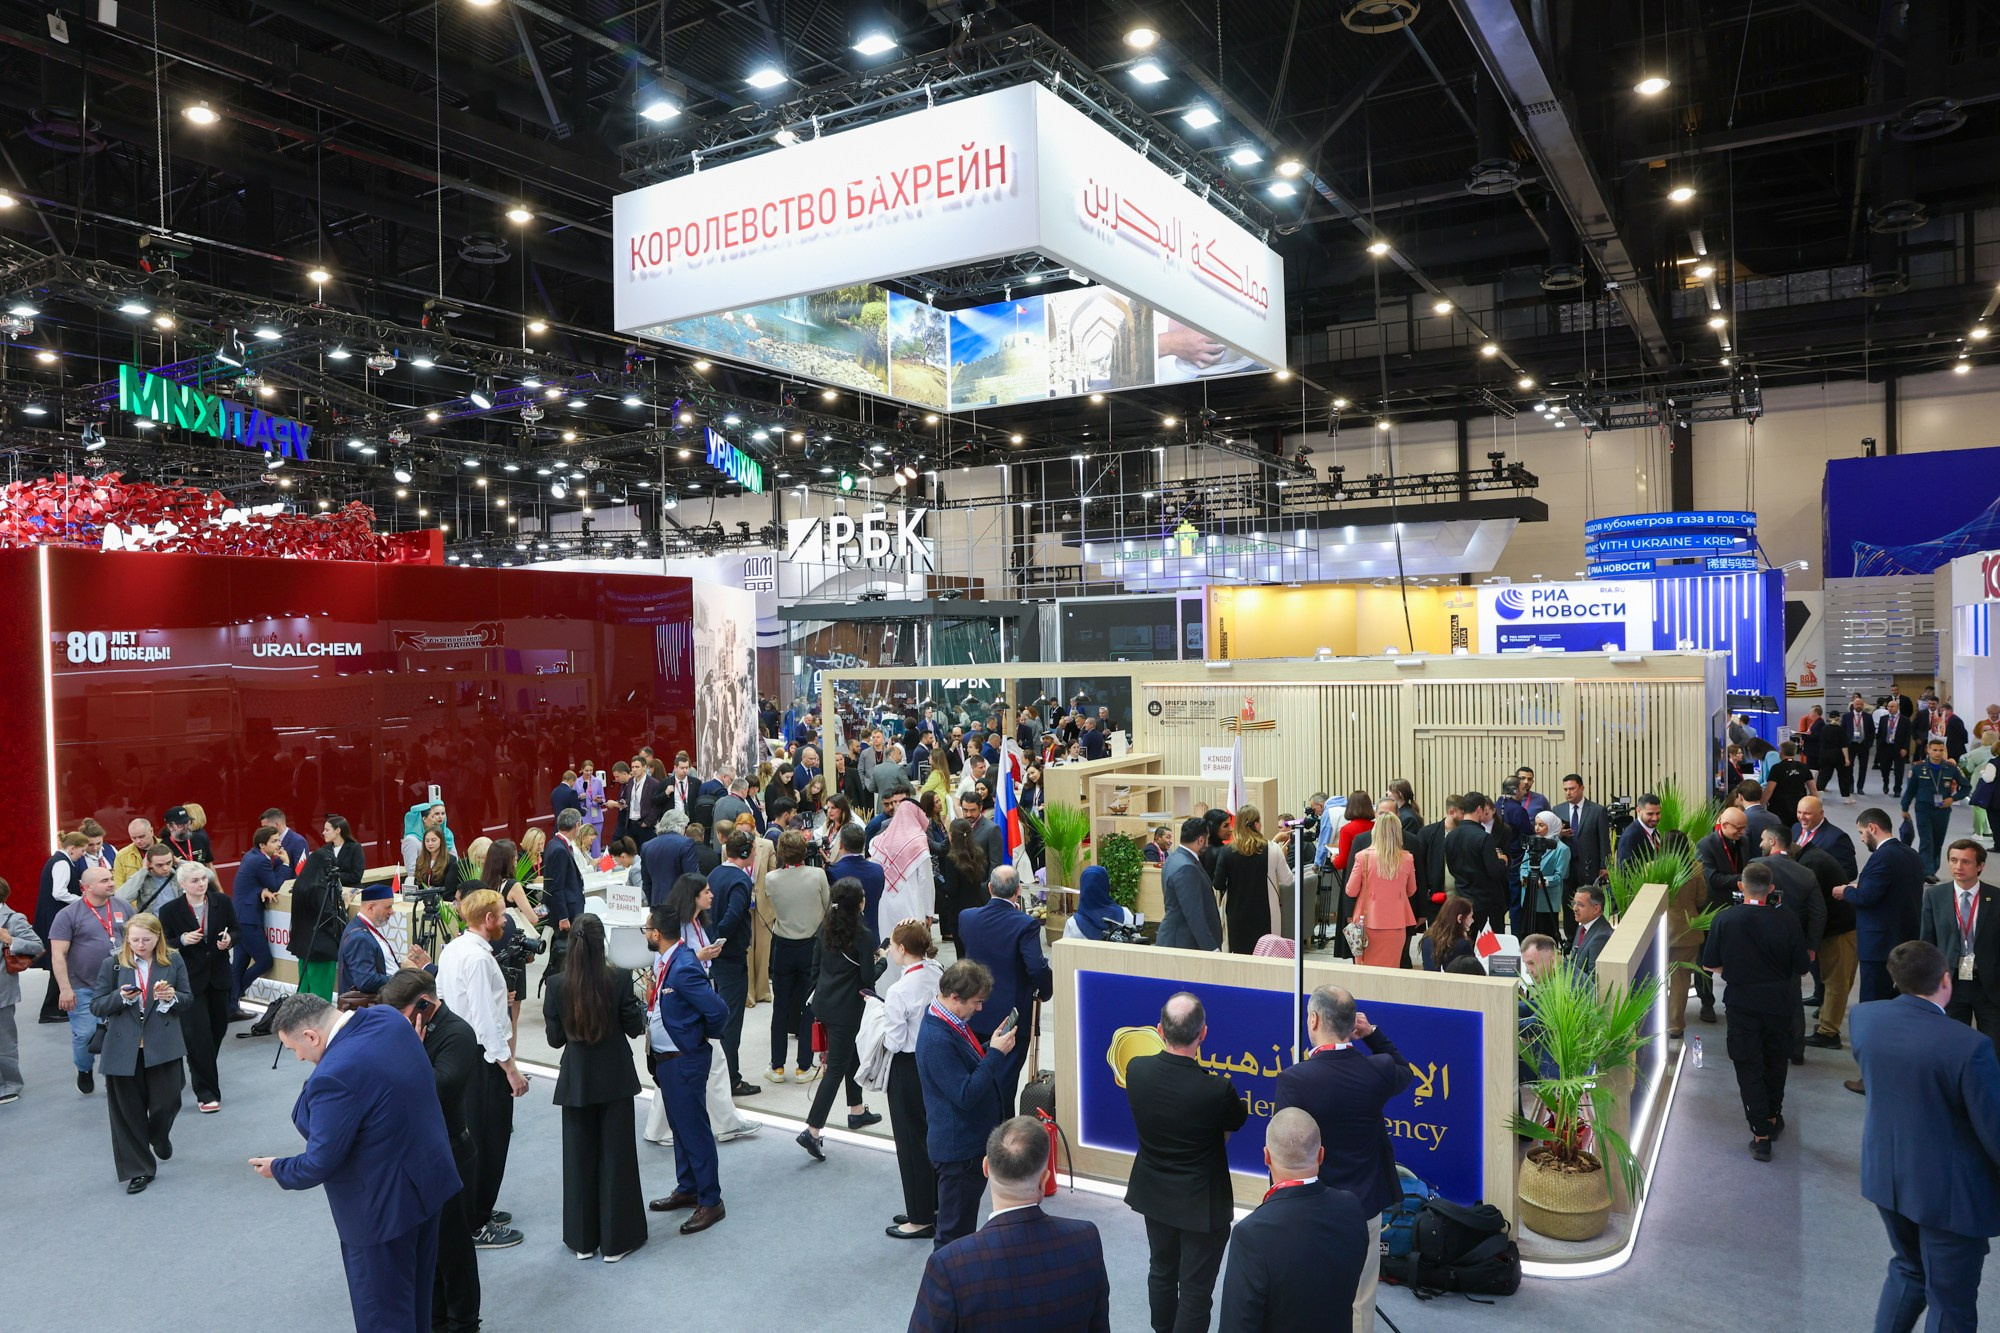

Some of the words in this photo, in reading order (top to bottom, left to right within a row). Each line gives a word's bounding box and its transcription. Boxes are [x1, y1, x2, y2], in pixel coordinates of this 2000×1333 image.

[630, 187, 837, 271] КОРОЛЕВСТВО
[846, 141, 1007, 219] БАХРЕЙН
[1083, 178, 1183, 260] البحرين
[1191, 231, 1269, 310] مملكة
[704, 426, 763, 494] УРАЛХИМ
[1603, 516, 1673, 531] кубометров
[1677, 515, 1704, 524] газа
[1707, 515, 1714, 523] в
[1717, 514, 1735, 524] год
[829, 507, 931, 561] РБК
[1631, 537, 1692, 549] UKRAINE
[1113, 548, 1178, 560] ROSNEFT
[1603, 562, 1650, 573] НОВОСТИ
[1532, 588, 1569, 602] РИА
[1532, 602, 1626, 618] НОВОСТИ
[110, 631, 137, 645] ЛЕТ
[67, 631, 107, 664] 80
[111, 646, 171, 662] ПОБЕДЫ!
[252, 642, 362, 657] URALCHEM
[612, 893, 636, 902] KINGDOM
[616, 903, 640, 912] BAHRAIN
